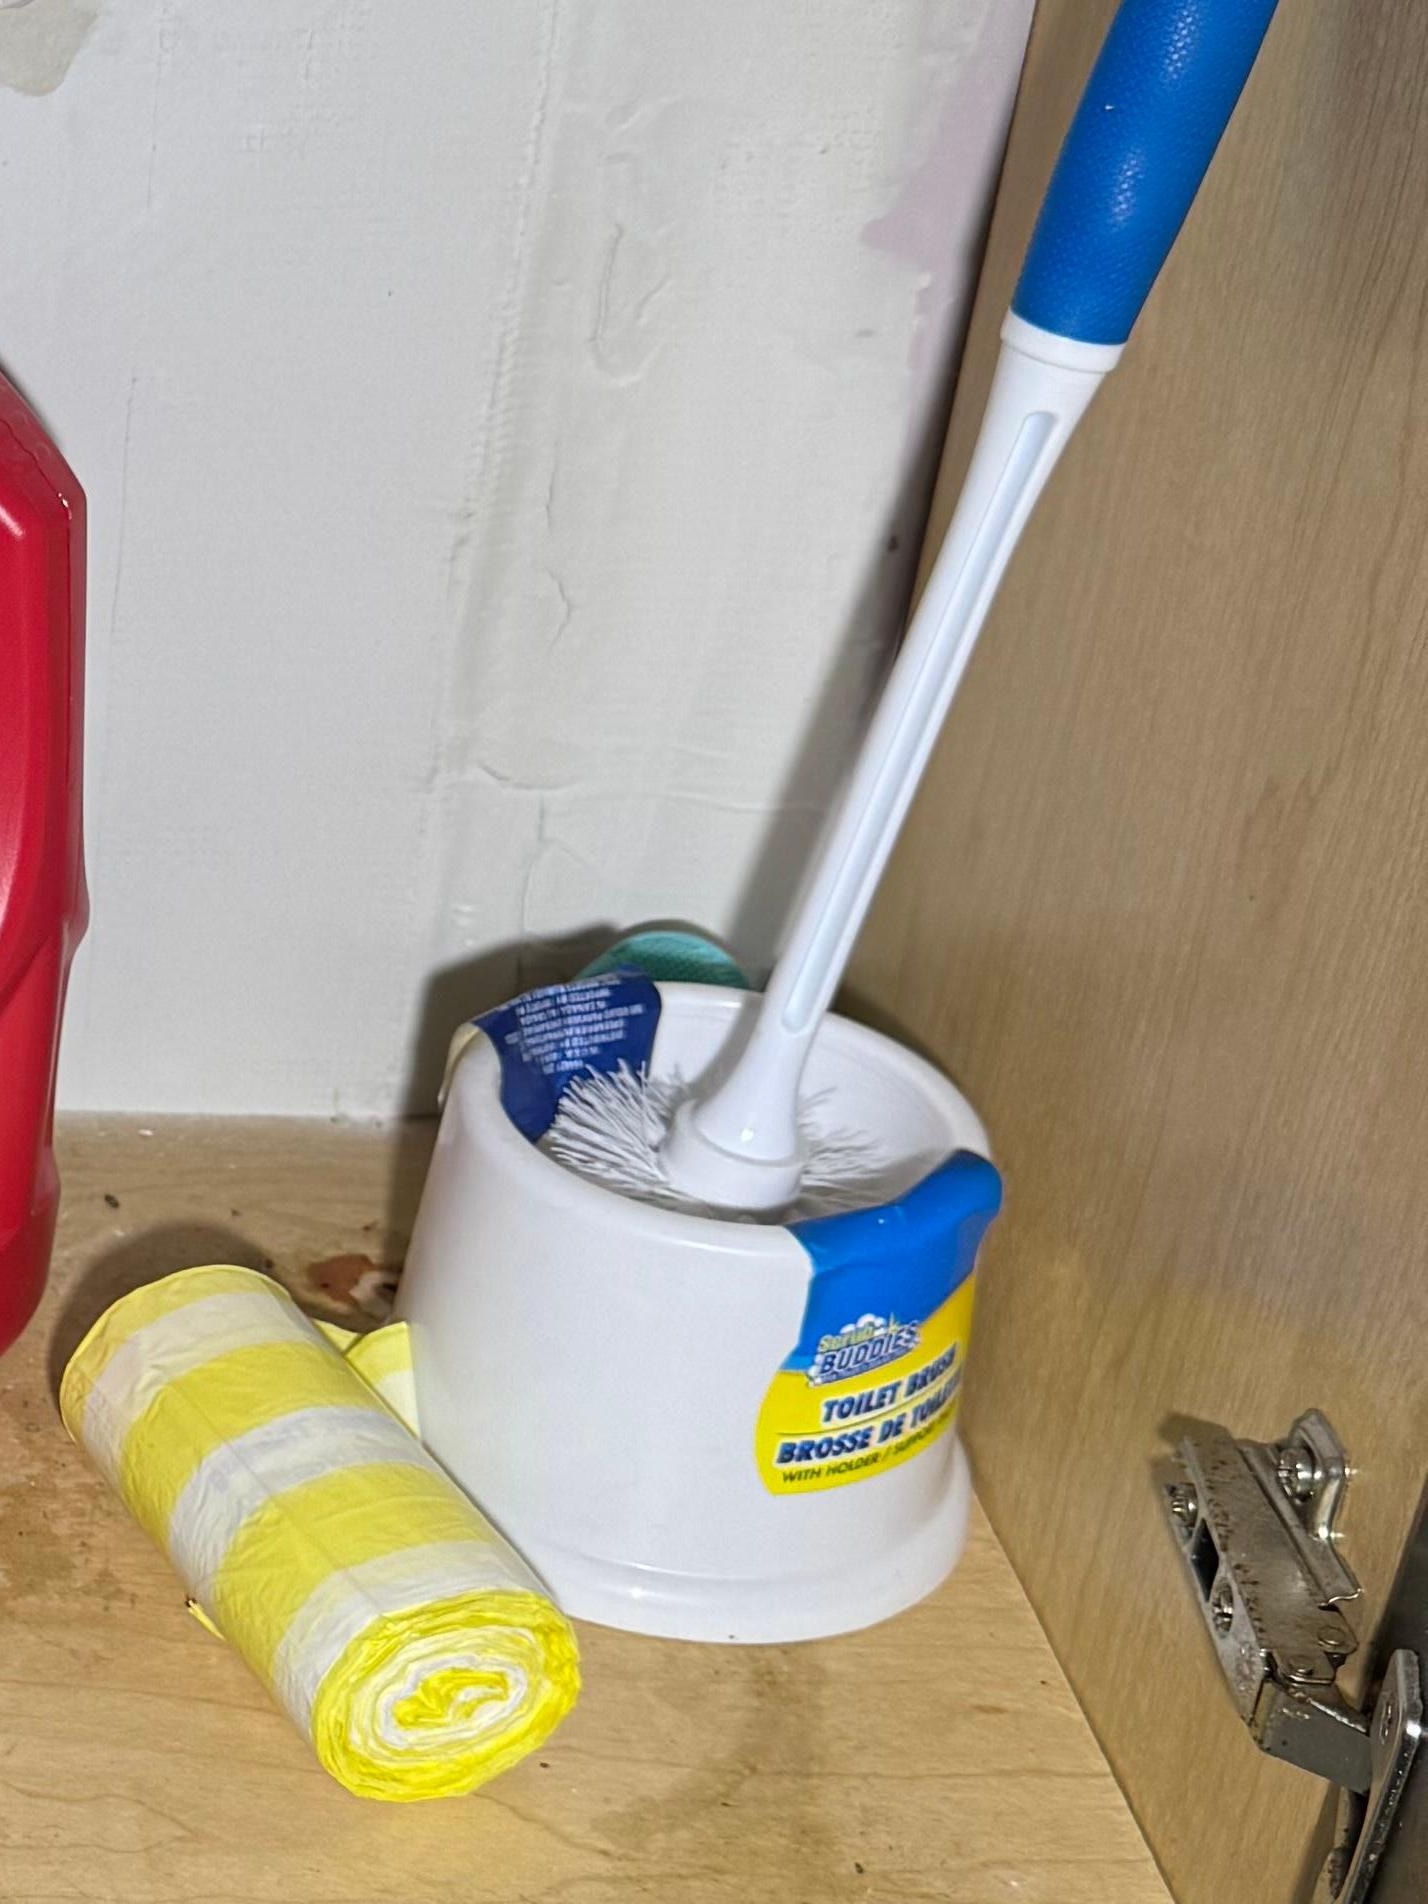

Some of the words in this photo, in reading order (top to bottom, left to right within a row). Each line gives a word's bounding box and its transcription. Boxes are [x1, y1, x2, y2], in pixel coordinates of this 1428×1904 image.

[822, 1381, 902, 1423] TOILET
[776, 1426, 874, 1464] BROSSE
[878, 1412, 906, 1443] DE
[782, 1467, 822, 1484] WITH
